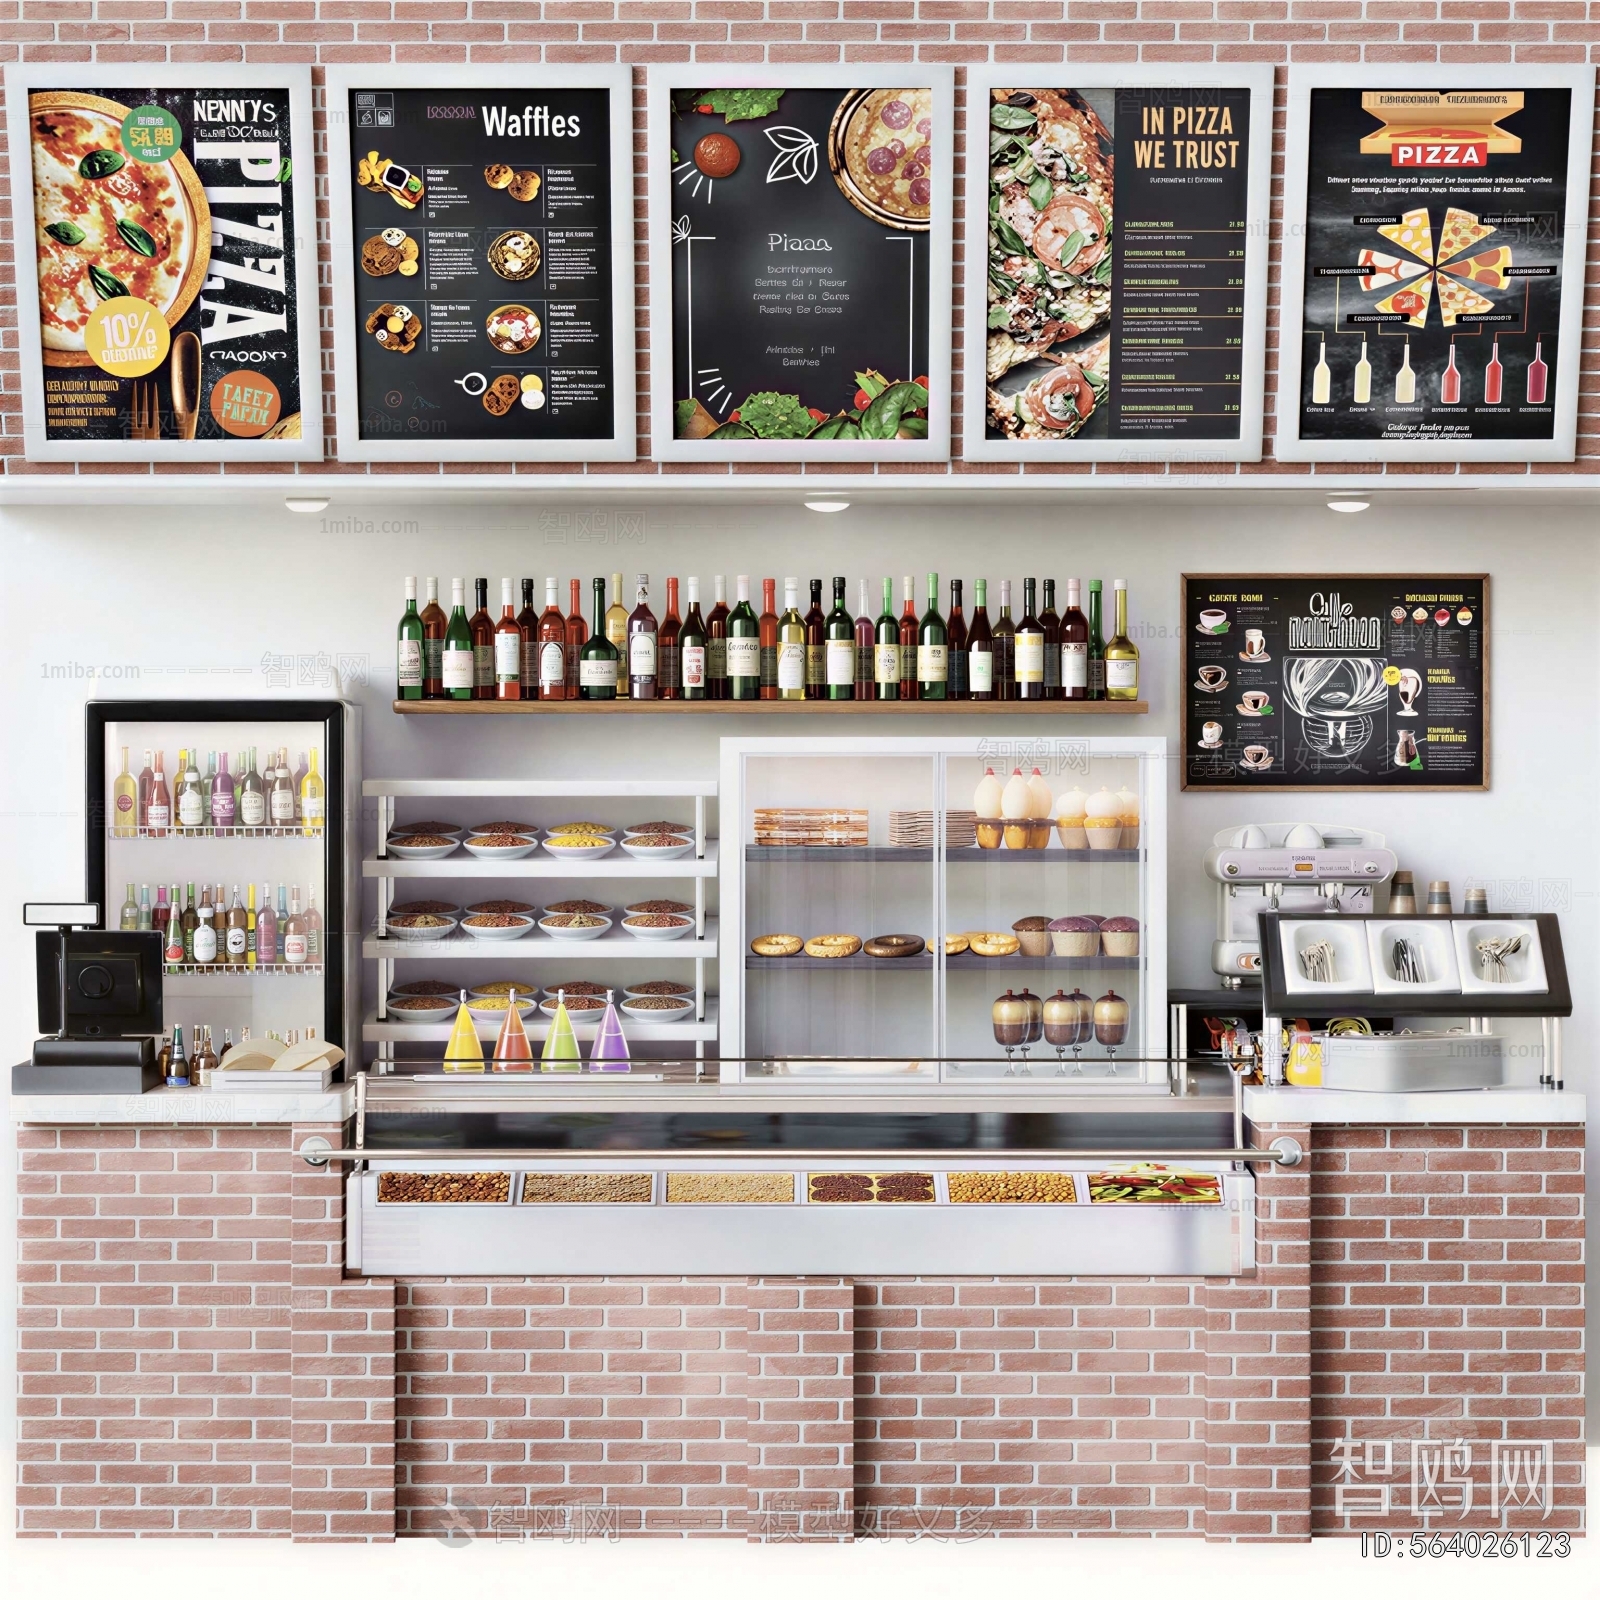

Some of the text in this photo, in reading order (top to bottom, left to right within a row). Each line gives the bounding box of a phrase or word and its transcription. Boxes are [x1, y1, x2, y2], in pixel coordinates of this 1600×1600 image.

[482, 105, 581, 137] Waffles
[1143, 107, 1233, 135] IN PIZZA
[1134, 140, 1240, 169] WE TRUST
[1398, 146, 1480, 164] PIZZA
[194, 138, 288, 346] PIZZA
[100, 311, 156, 350] 10%
